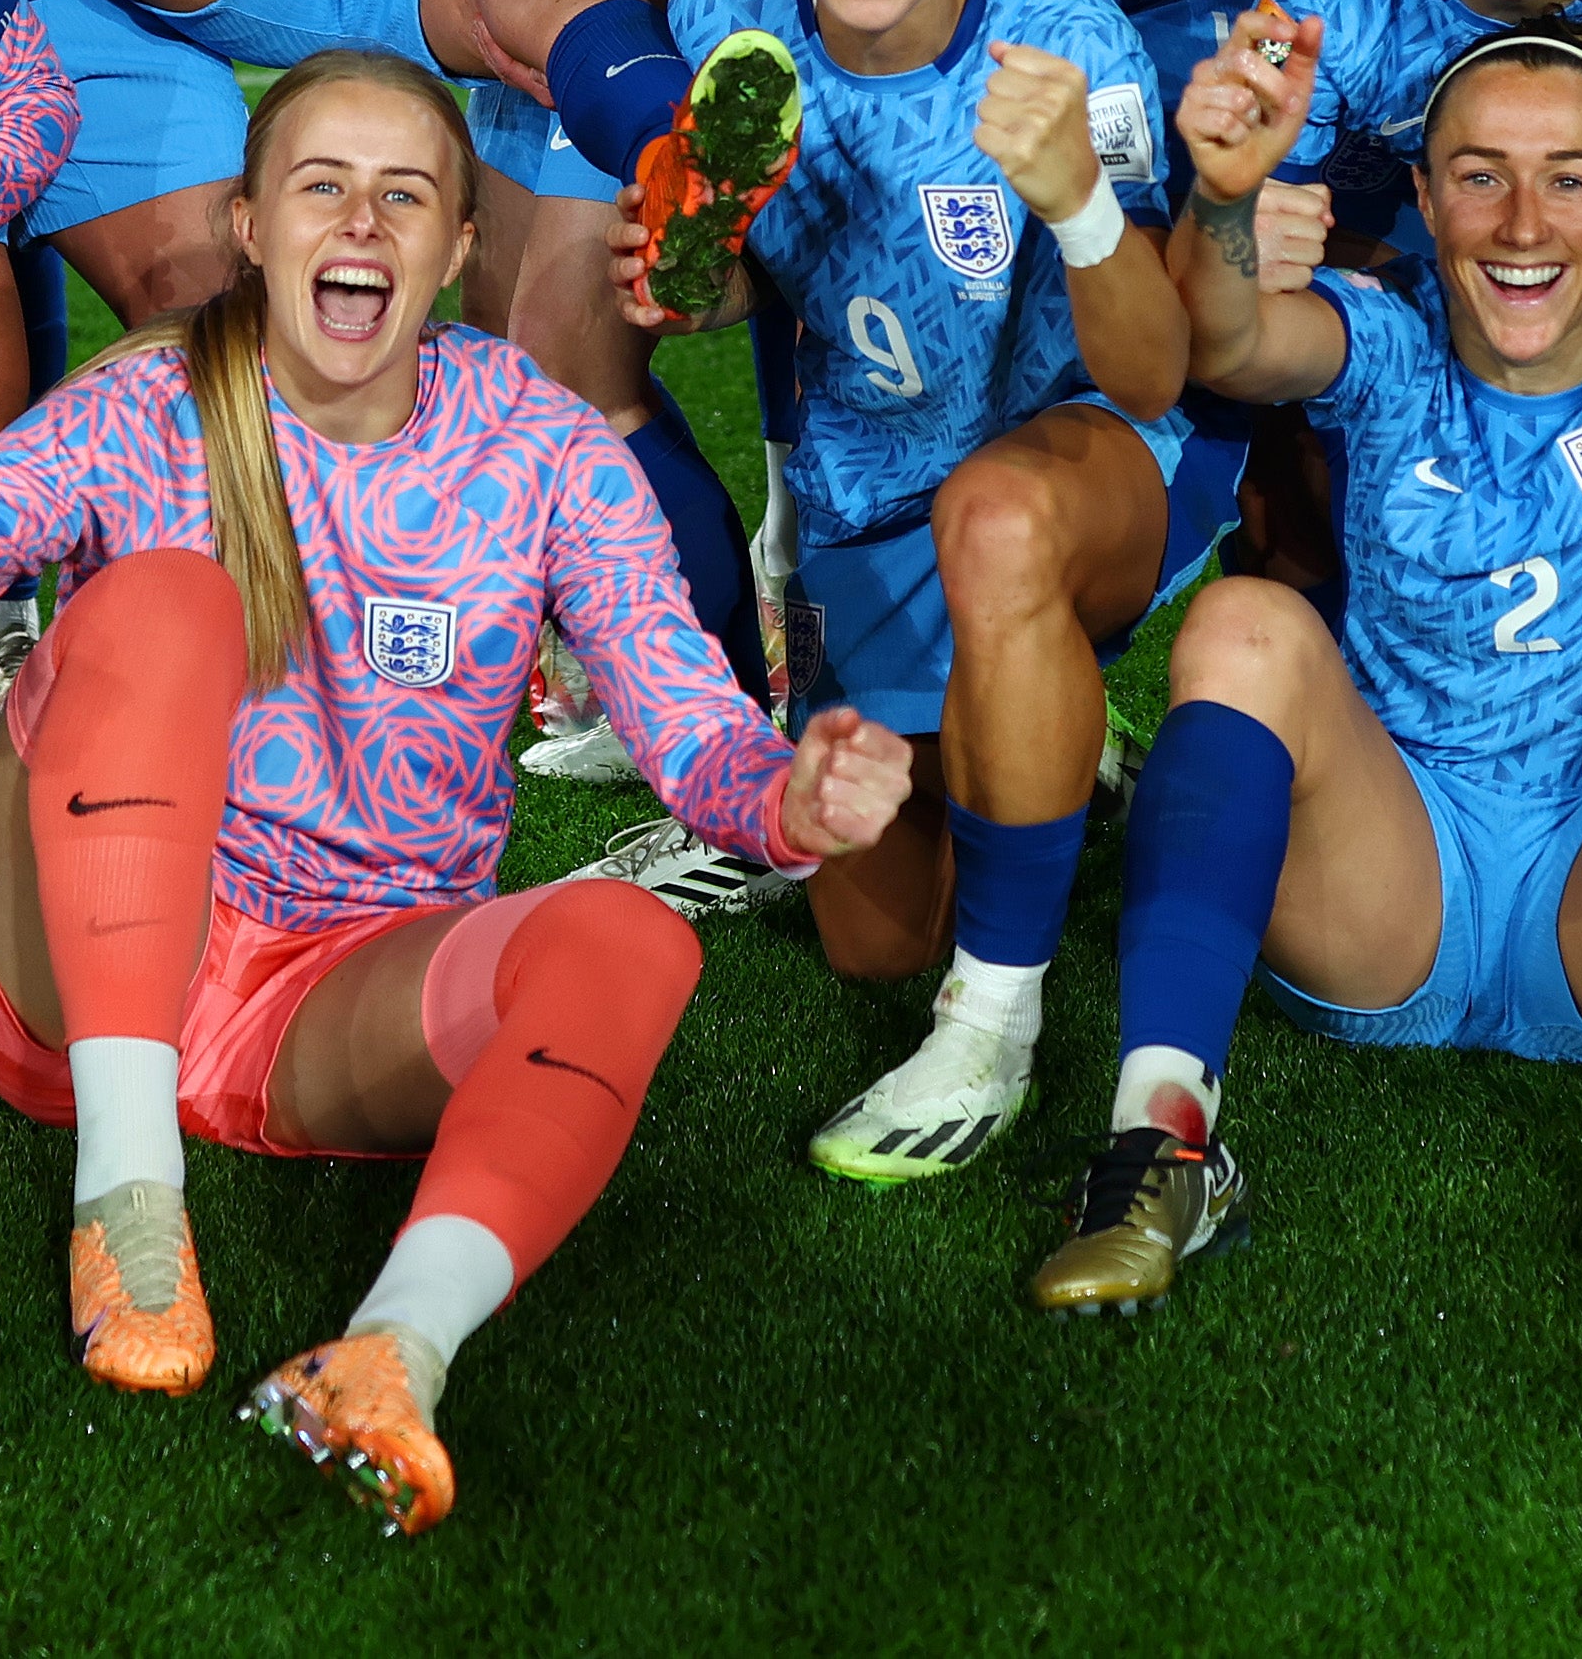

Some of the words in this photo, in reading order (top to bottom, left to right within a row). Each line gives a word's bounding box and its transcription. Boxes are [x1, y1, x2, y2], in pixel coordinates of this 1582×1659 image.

[1091, 115, 1133, 141] NITES
[847, 296, 923, 398] 9
[1489, 556, 1563, 654] 2
